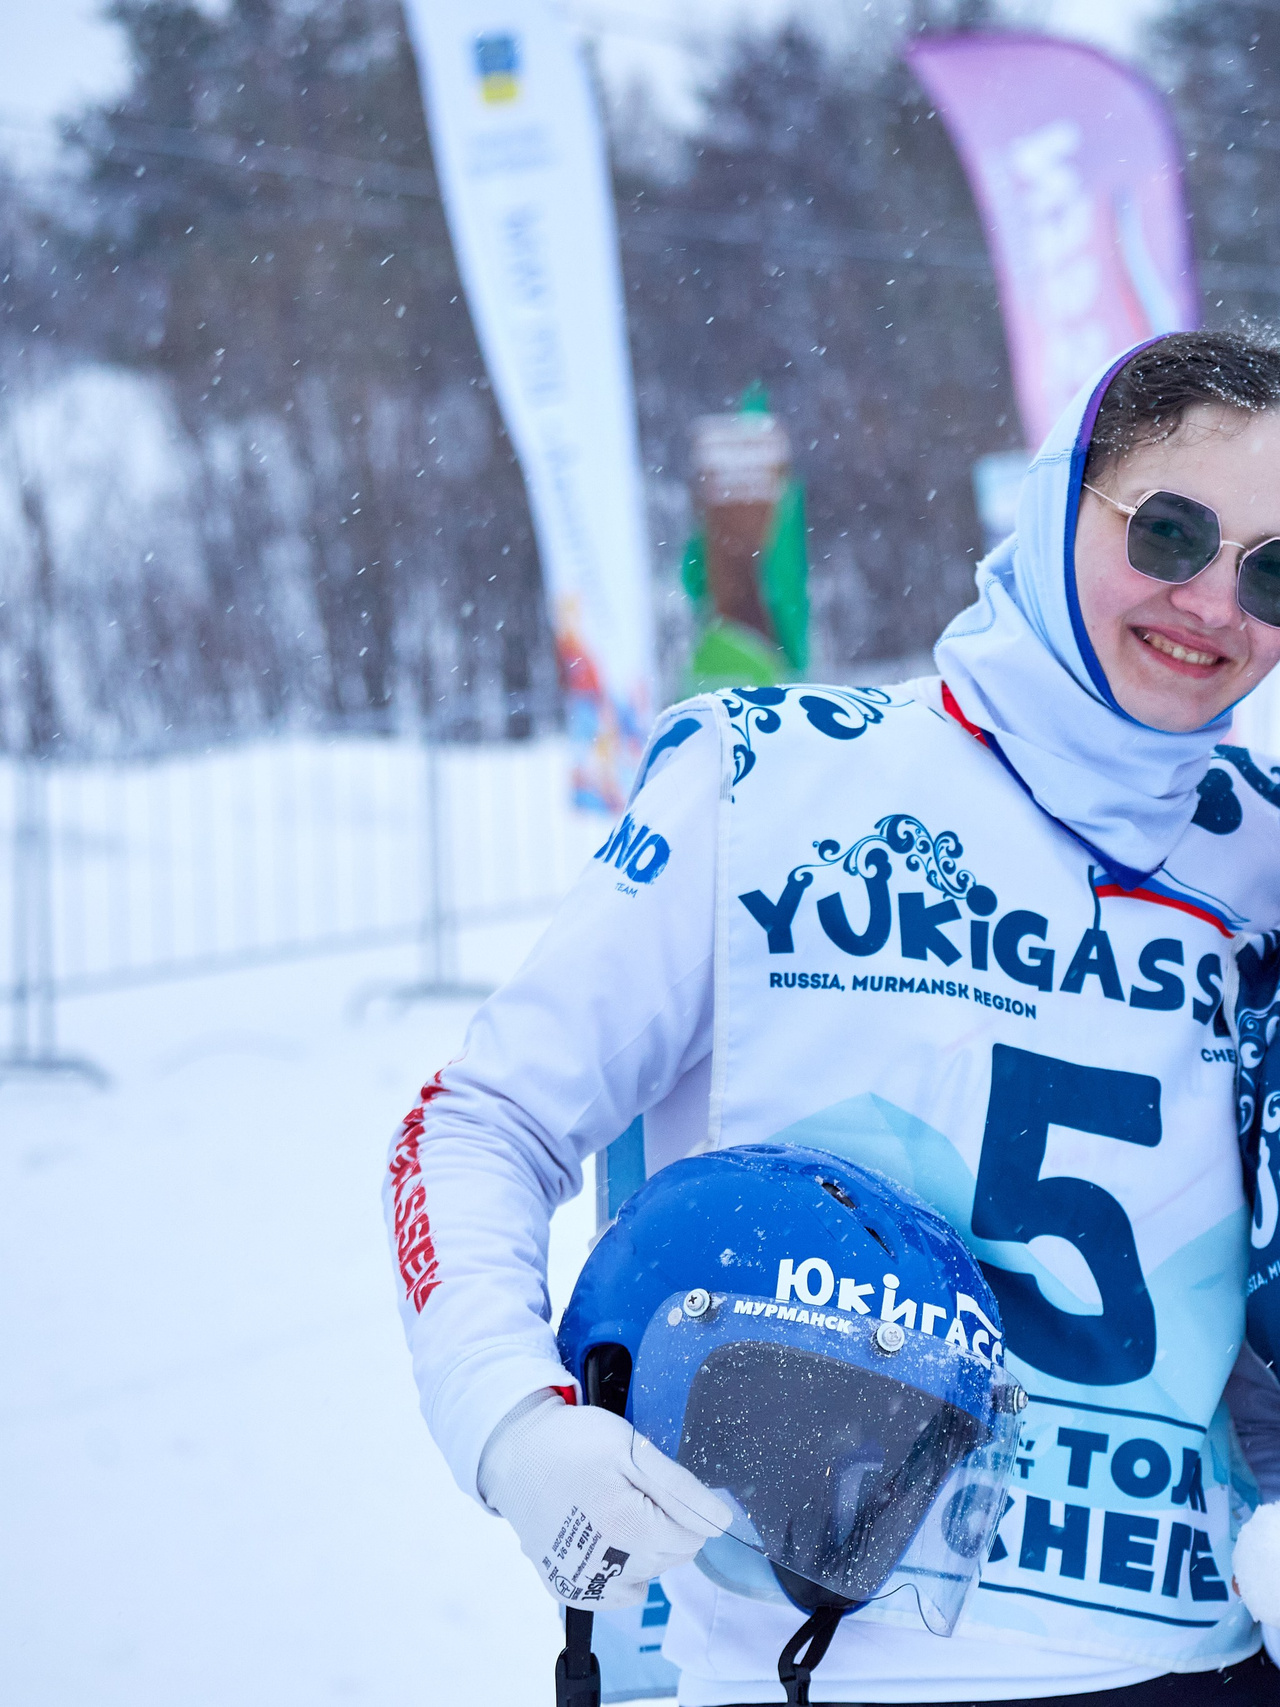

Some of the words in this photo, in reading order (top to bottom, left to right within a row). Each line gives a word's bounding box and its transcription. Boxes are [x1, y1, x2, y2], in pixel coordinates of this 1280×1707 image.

[615, 882, 638, 898] TEAM
[769, 972, 846, 992] RUSSIA,
[852, 975, 969, 1000] MURMANSK
[973, 990, 1037, 1019] REGION
[970, 1042, 1163, 1386] 5
[733, 1300, 853, 1335] МУРМАНСК
[564, 1516, 572, 1528] ТС
[570, 1505, 578, 1517] ТР
[564, 1512, 586, 1548] Размер
[577, 1521, 593, 1551] Atlas
